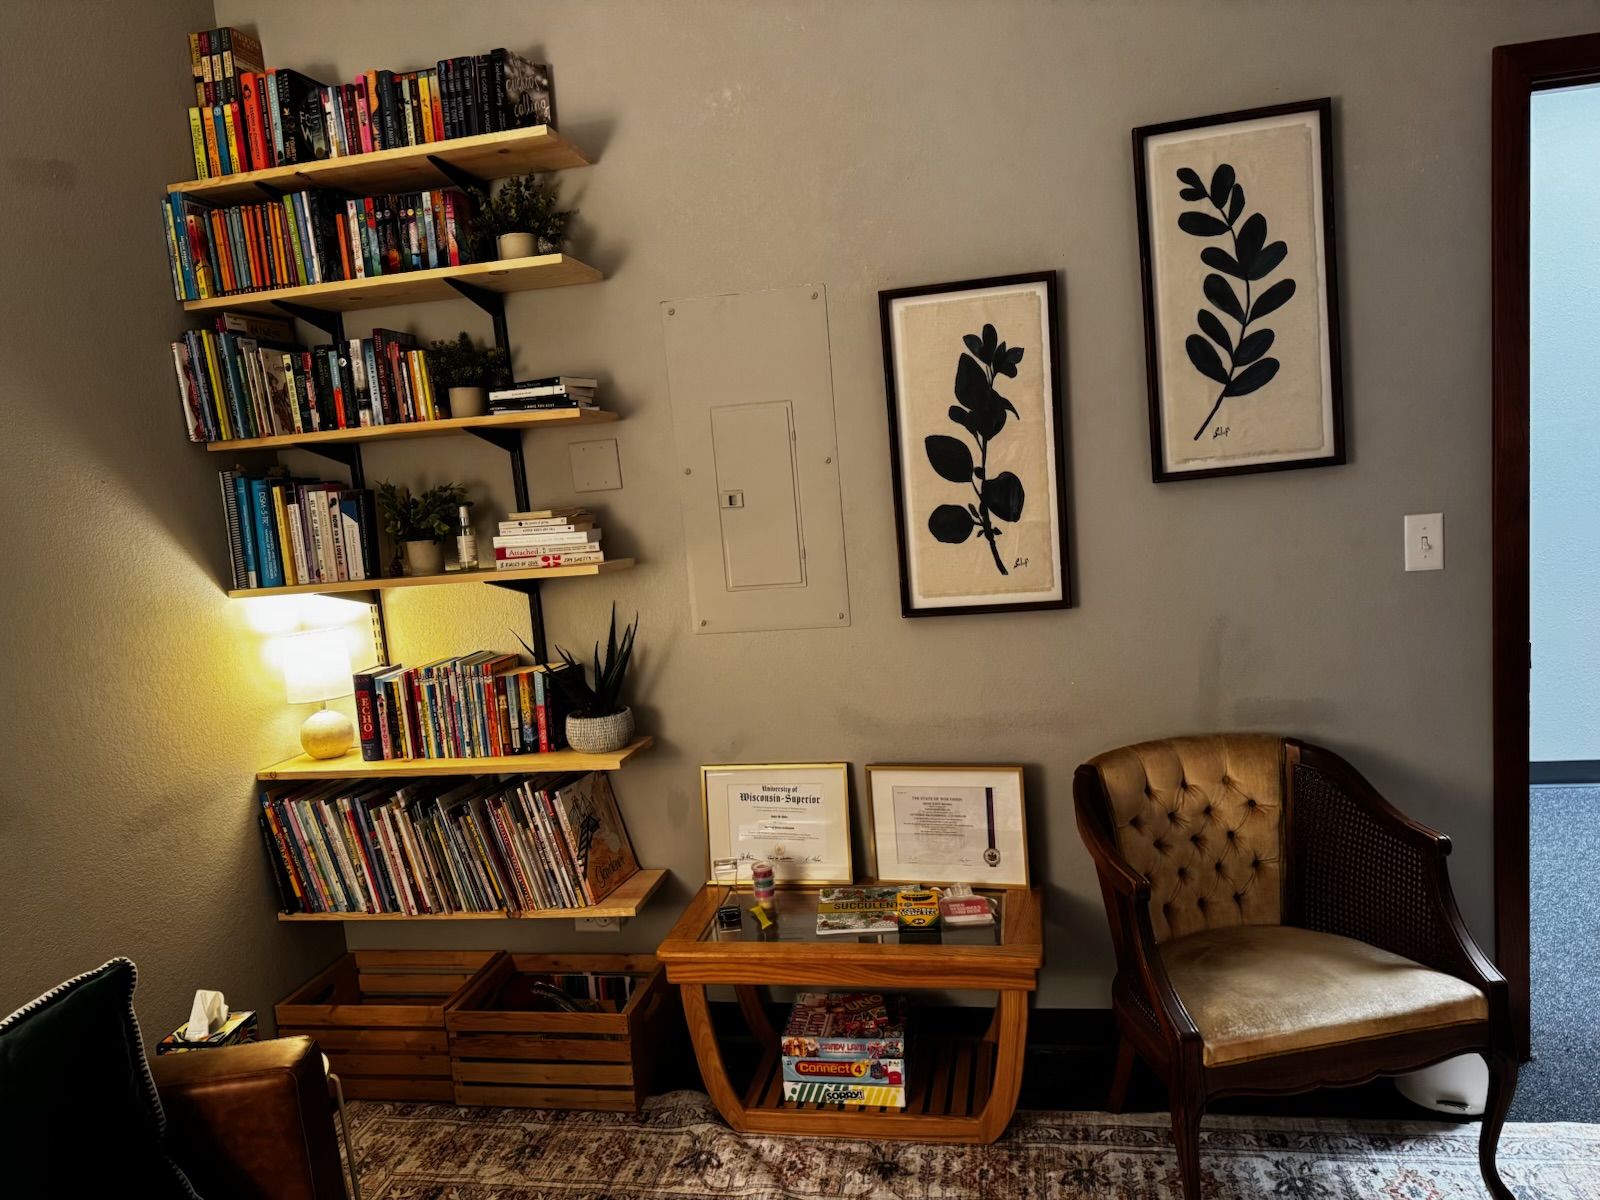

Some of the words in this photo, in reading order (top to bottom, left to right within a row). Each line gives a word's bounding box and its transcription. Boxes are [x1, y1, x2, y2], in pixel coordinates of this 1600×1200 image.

[316, 359, 326, 386] MORTON
[361, 698, 372, 732] ECHO
[762, 785, 791, 793] University
[740, 792, 820, 805] Wisconsin-Superior
[274, 833, 287, 857] WORLD
[282, 857, 294, 877] ATLAS
[844, 994, 883, 1010] UNO
[820, 1043, 845, 1051] CANDY
[800, 1064, 850, 1073] Connect
[854, 1065, 863, 1074] 4
[826, 1091, 863, 1100] SORRY!
